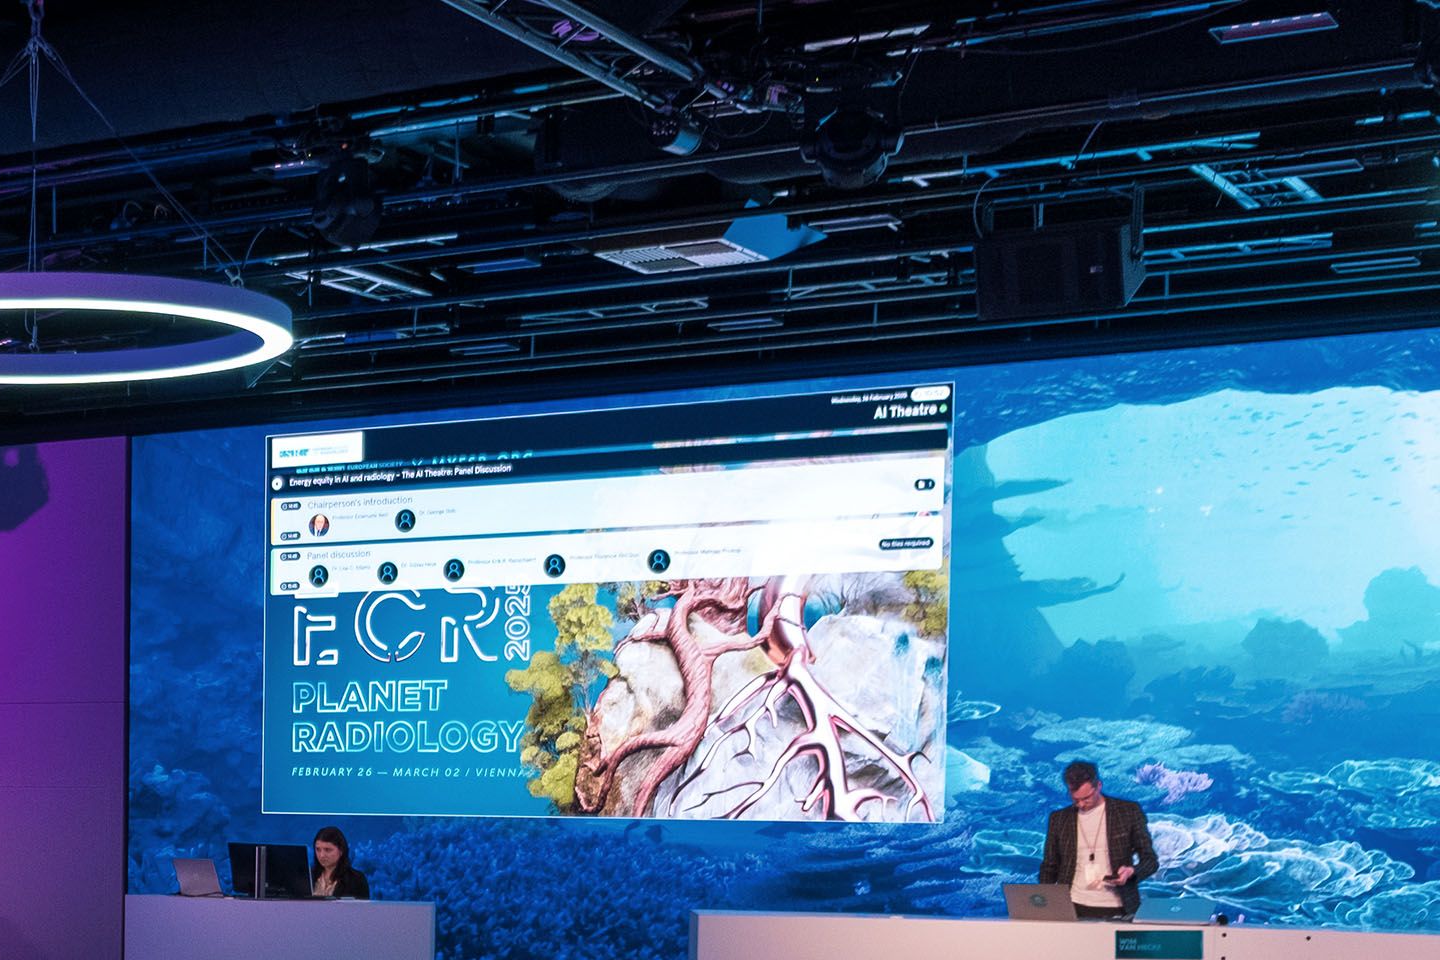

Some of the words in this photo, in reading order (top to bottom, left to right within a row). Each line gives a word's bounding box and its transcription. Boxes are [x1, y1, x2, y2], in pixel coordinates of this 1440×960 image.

[873, 405, 887, 419] AI
[889, 403, 938, 418] Theatre
[347, 463, 378, 472] EUROPEAN
[289, 477, 311, 488] Energy
[312, 476, 334, 487] equity
[334, 475, 341, 484] in
[341, 475, 349, 483] AI
[349, 474, 363, 482] and
[364, 472, 395, 482] radiology
[402, 469, 415, 478] The
[415, 469, 424, 478] AI
[424, 467, 453, 477] Theatre:
[454, 466, 473, 475] Panel
[474, 464, 512, 475] Discussion
[307, 498, 361, 510] Chairperson's
[362, 496, 413, 506] introduction
[904, 539, 931, 547] required
[306, 551, 329, 560] Panel
[330, 549, 371, 559] discussion
[292, 680, 448, 714] PLANET
[292, 720, 525, 754] RADIOLOGY
[291, 767, 353, 778] FEBRUARY
[357, 767, 372, 777] 26
[392, 767, 440, 777] MARCH
[444, 767, 460, 777] 02
